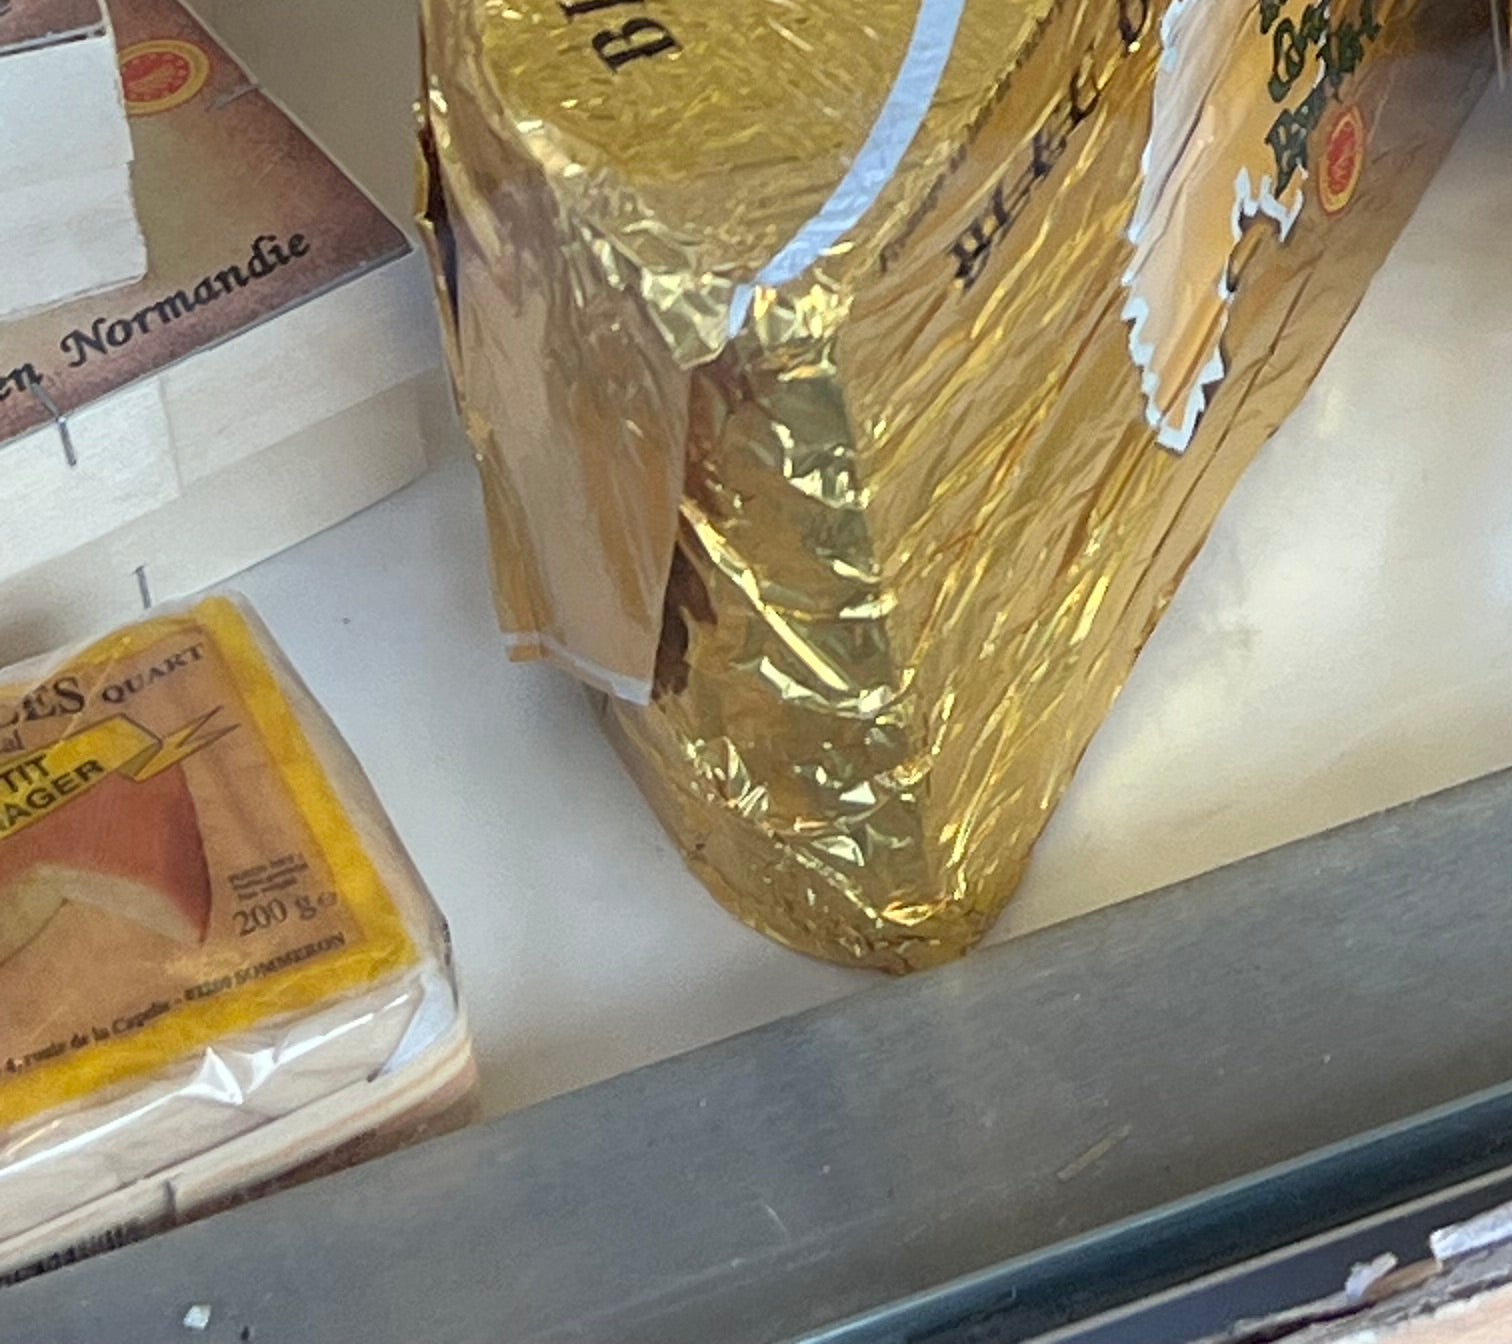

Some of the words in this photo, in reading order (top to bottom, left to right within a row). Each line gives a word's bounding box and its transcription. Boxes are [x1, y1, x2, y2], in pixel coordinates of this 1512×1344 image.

[59, 231, 312, 369] Normandie
[103, 644, 206, 704] QUART
[0, 758, 106, 832] AGER
[232, 896, 288, 938] 200
